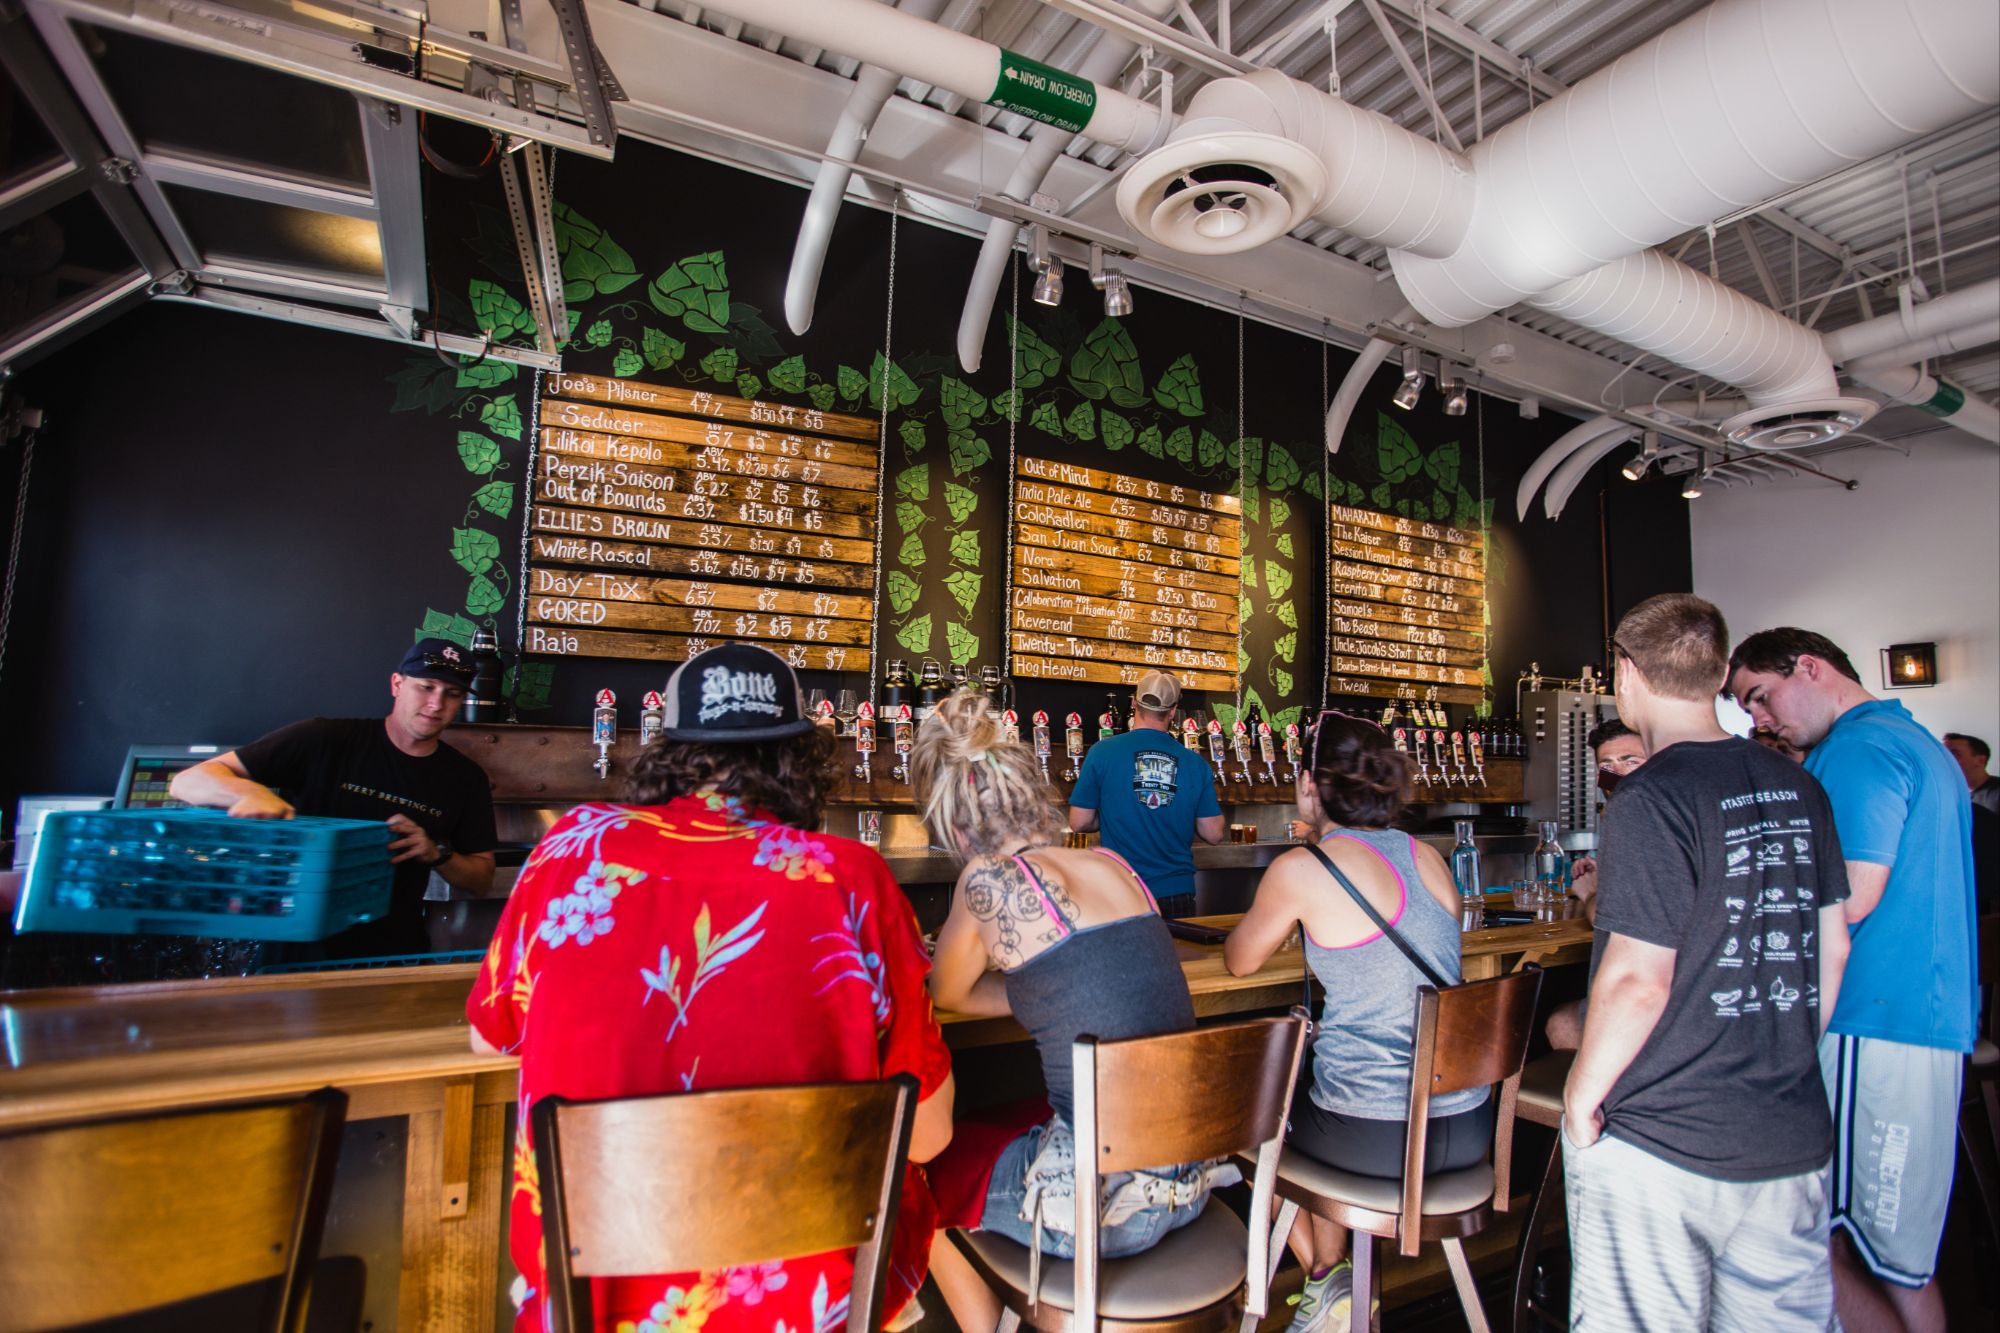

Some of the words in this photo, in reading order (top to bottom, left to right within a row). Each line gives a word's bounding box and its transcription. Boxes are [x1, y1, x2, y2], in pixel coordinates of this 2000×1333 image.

[1019, 70, 1046, 91] DRAIN
[1048, 80, 1093, 107] OVERFLOW
[1007, 103, 1056, 123] OVERFLOW
[1054, 118, 1081, 132] DRAIN
[548, 372, 596, 394] Joe's
[607, 380, 658, 402] Pilsner
[778, 408, 795, 425] $4
[803, 414, 824, 430] $5
[561, 405, 643, 433] Seducer
[706, 430, 733, 448] 5%
[748, 435, 765, 451] $2
[780, 439, 800, 456] $5
[815, 444, 831, 460] $6
[545, 428, 596, 454] Lilikoi
[606, 435, 662, 463] Kepolo
[696, 455, 731, 472] 5.4%
[770, 463, 790, 478] $6
[801, 466, 820, 483] $7
[546, 456, 606, 483] Perzik
[612, 463, 674, 491] Saison
[745, 485, 762, 501] $2
[771, 488, 789, 505] $5
[802, 492, 820, 507] $6
[1024, 458, 1046, 476] Out
[1049, 464, 1059, 478] of
[1061, 464, 1091, 487] Mind
[1146, 481, 1162, 499] $2
[1171, 486, 1185, 503] $5
[545, 479, 578, 502] Out
[581, 484, 598, 504] of
[604, 484, 667, 512] Bounds
[683, 501, 715, 518] 6.3%
[776, 508, 793, 526] $4
[804, 512, 823, 529] $5
[1017, 503, 1089, 530] ColoRadler
[1019, 481, 1044, 500] India
[1047, 487, 1071, 504] Pale
[1074, 493, 1092, 508] Ale
[1174, 512, 1187, 527] $4
[1191, 516, 1208, 531] $5
[1333, 505, 1383, 528] MAHARAJA
[538, 508, 603, 532] ELLIE'S
[612, 516, 671, 539] BROWN
[818, 544, 834, 558] $5
[1021, 525, 1048, 546] San
[1052, 529, 1087, 552] Juan
[1091, 536, 1120, 556] Sour
[1138, 548, 1152, 562] 6%
[1169, 553, 1184, 567] $6
[1333, 523, 1353, 540] The
[1354, 526, 1381, 546] Kaiser
[539, 538, 588, 560] White
[590, 542, 651, 566] Rascal
[690, 559, 721, 575] 5.6%
[766, 564, 787, 582] $4
[795, 567, 815, 584] $5
[1023, 547, 1054, 567] Nora
[1121, 566, 1136, 579] 7%
[1153, 569, 1166, 584] $6
[1333, 540, 1364, 560] Session
[1365, 545, 1391, 563] Vienna
[1022, 567, 1081, 590] Salvation
[1335, 560, 1380, 583] Raspberry
[1381, 568, 1402, 583] Sour
[685, 590, 717, 607] 6.5%
[758, 593, 776, 611] $6
[814, 597, 839, 616] $12
[1015, 589, 1073, 609] Collaboration
[1076, 603, 1116, 617] Litigation
[1334, 579, 1367, 597] Eremita
[539, 598, 607, 624] GORED
[736, 616, 758, 636] $2
[769, 617, 792, 637] $5
[805, 621, 828, 640] $6
[1016, 610, 1073, 633] Reverend
[1177, 632, 1191, 646] $6
[1335, 617, 1352, 632] The
[1352, 619, 1380, 637] Beast
[533, 628, 578, 655] Raja
[788, 647, 807, 668] $6
[826, 649, 846, 671] $7
[1334, 637, 1355, 653] Uncle
[1355, 640, 1387, 657] Jacob's
[1388, 643, 1412, 660] Stout
[702, 665, 777, 705] Bone
[1016, 656, 1040, 677] Hog
[1041, 659, 1087, 678] Heaven
[1182, 673, 1196, 687] $6
[1337, 677, 1370, 694] Tweak
[378, 791, 427, 812] BREWING
